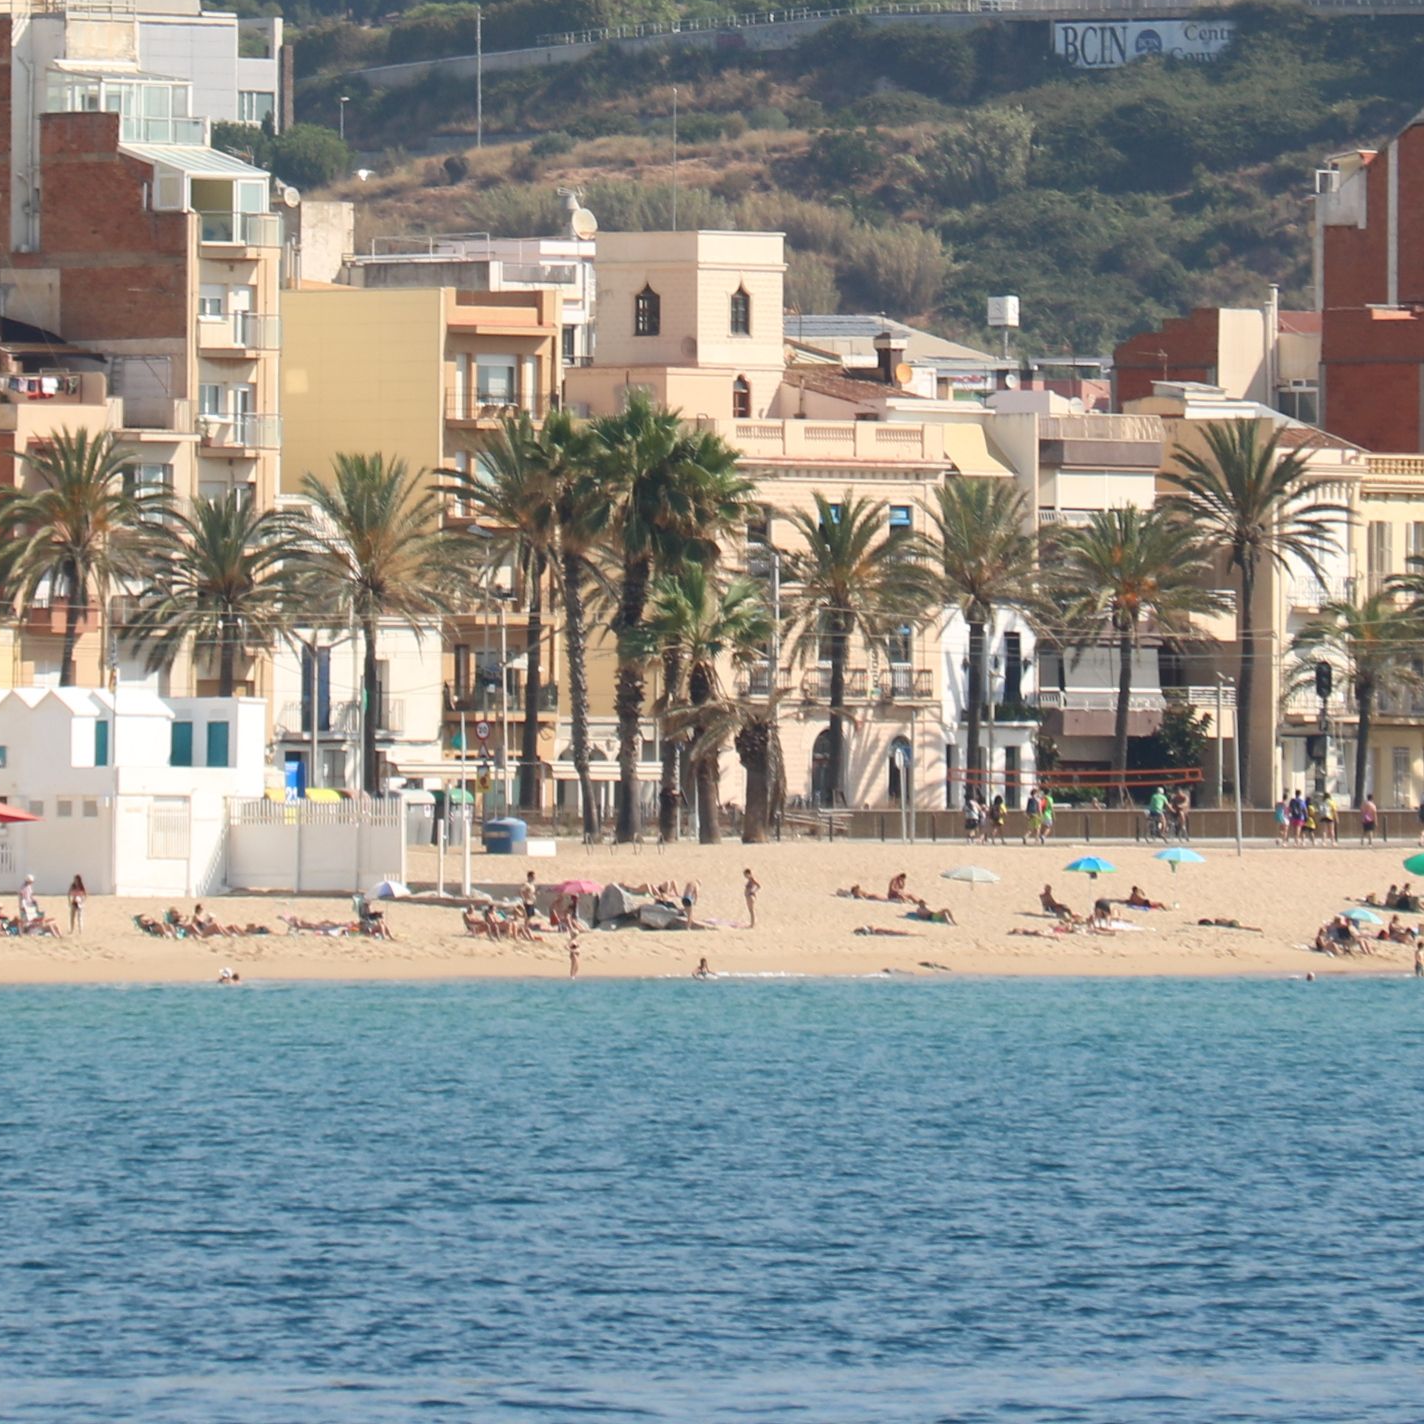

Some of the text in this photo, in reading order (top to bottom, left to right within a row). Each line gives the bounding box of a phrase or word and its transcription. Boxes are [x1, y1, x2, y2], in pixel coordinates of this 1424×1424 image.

[1184, 24, 1234, 42] Centr
[1062, 26, 1128, 65] BCIN
[1171, 45, 1217, 64] Conv
